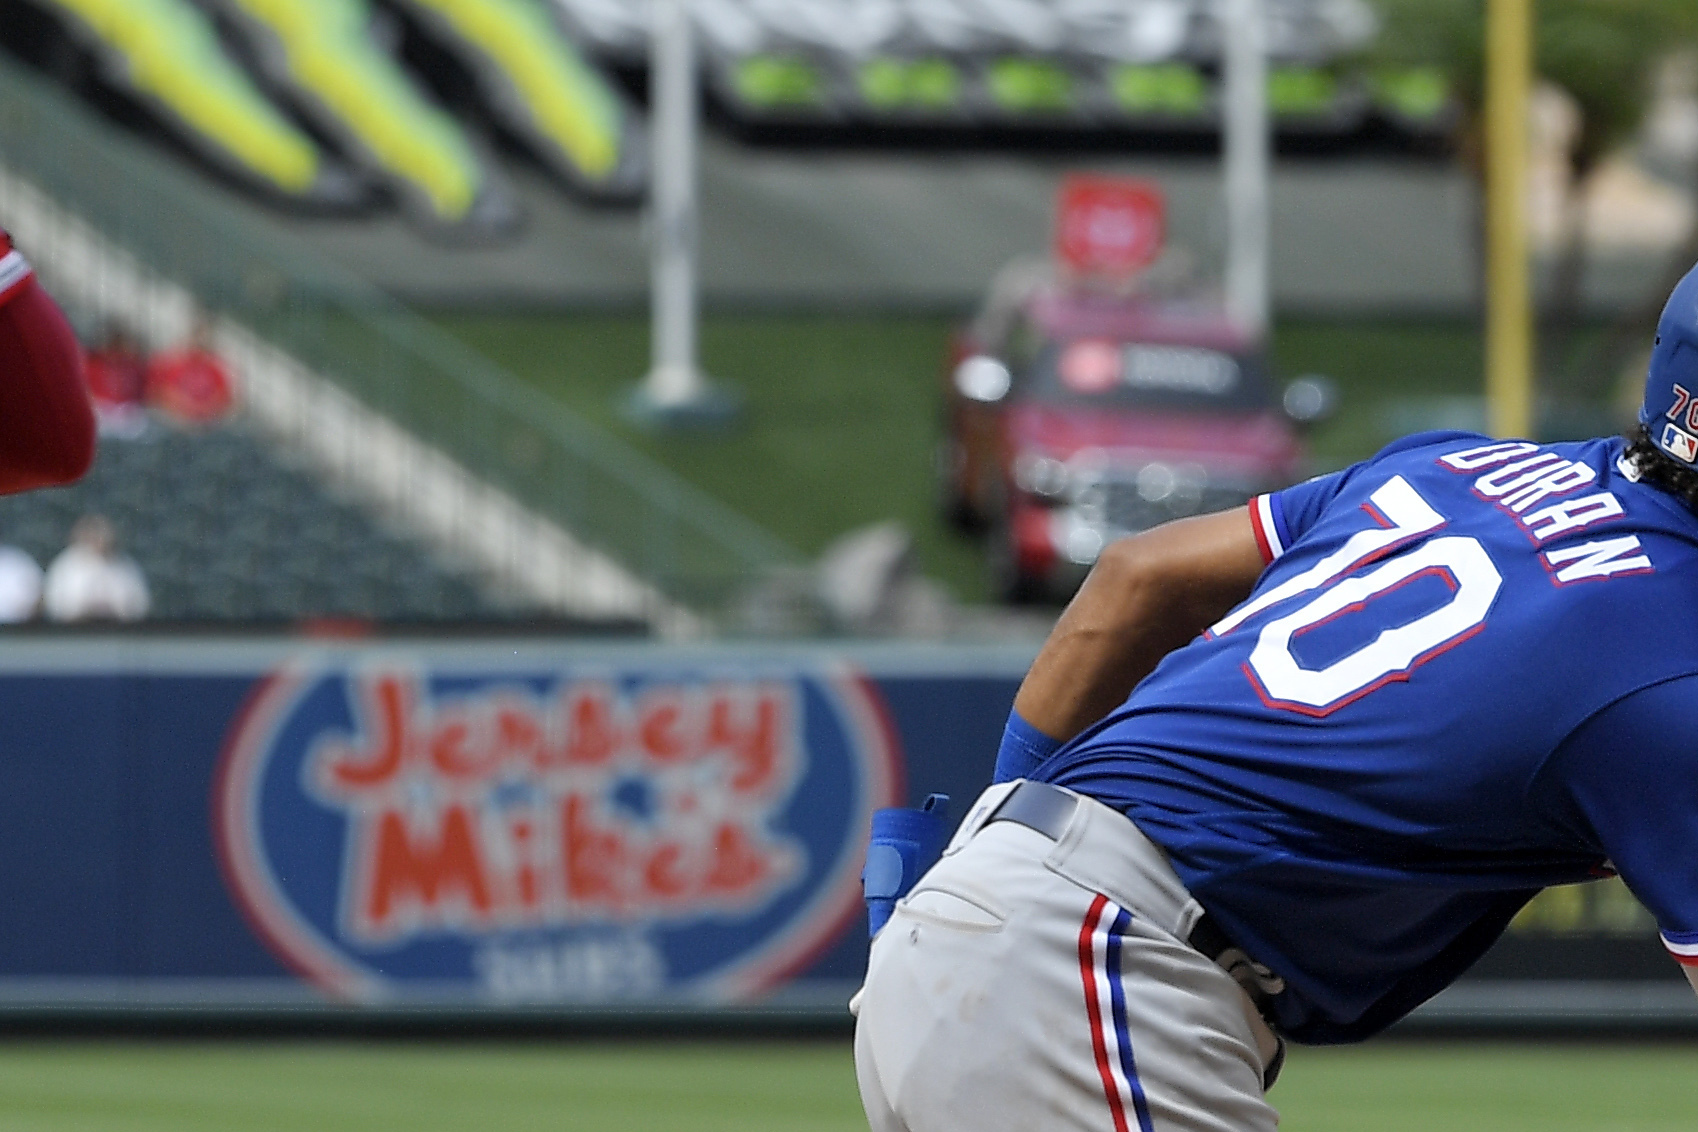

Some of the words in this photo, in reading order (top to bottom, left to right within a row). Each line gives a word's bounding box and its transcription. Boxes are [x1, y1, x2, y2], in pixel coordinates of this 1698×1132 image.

[1435, 442, 1655, 588] DURAN
[1201, 474, 1503, 718] 70
[318, 668, 790, 798] Jersey
